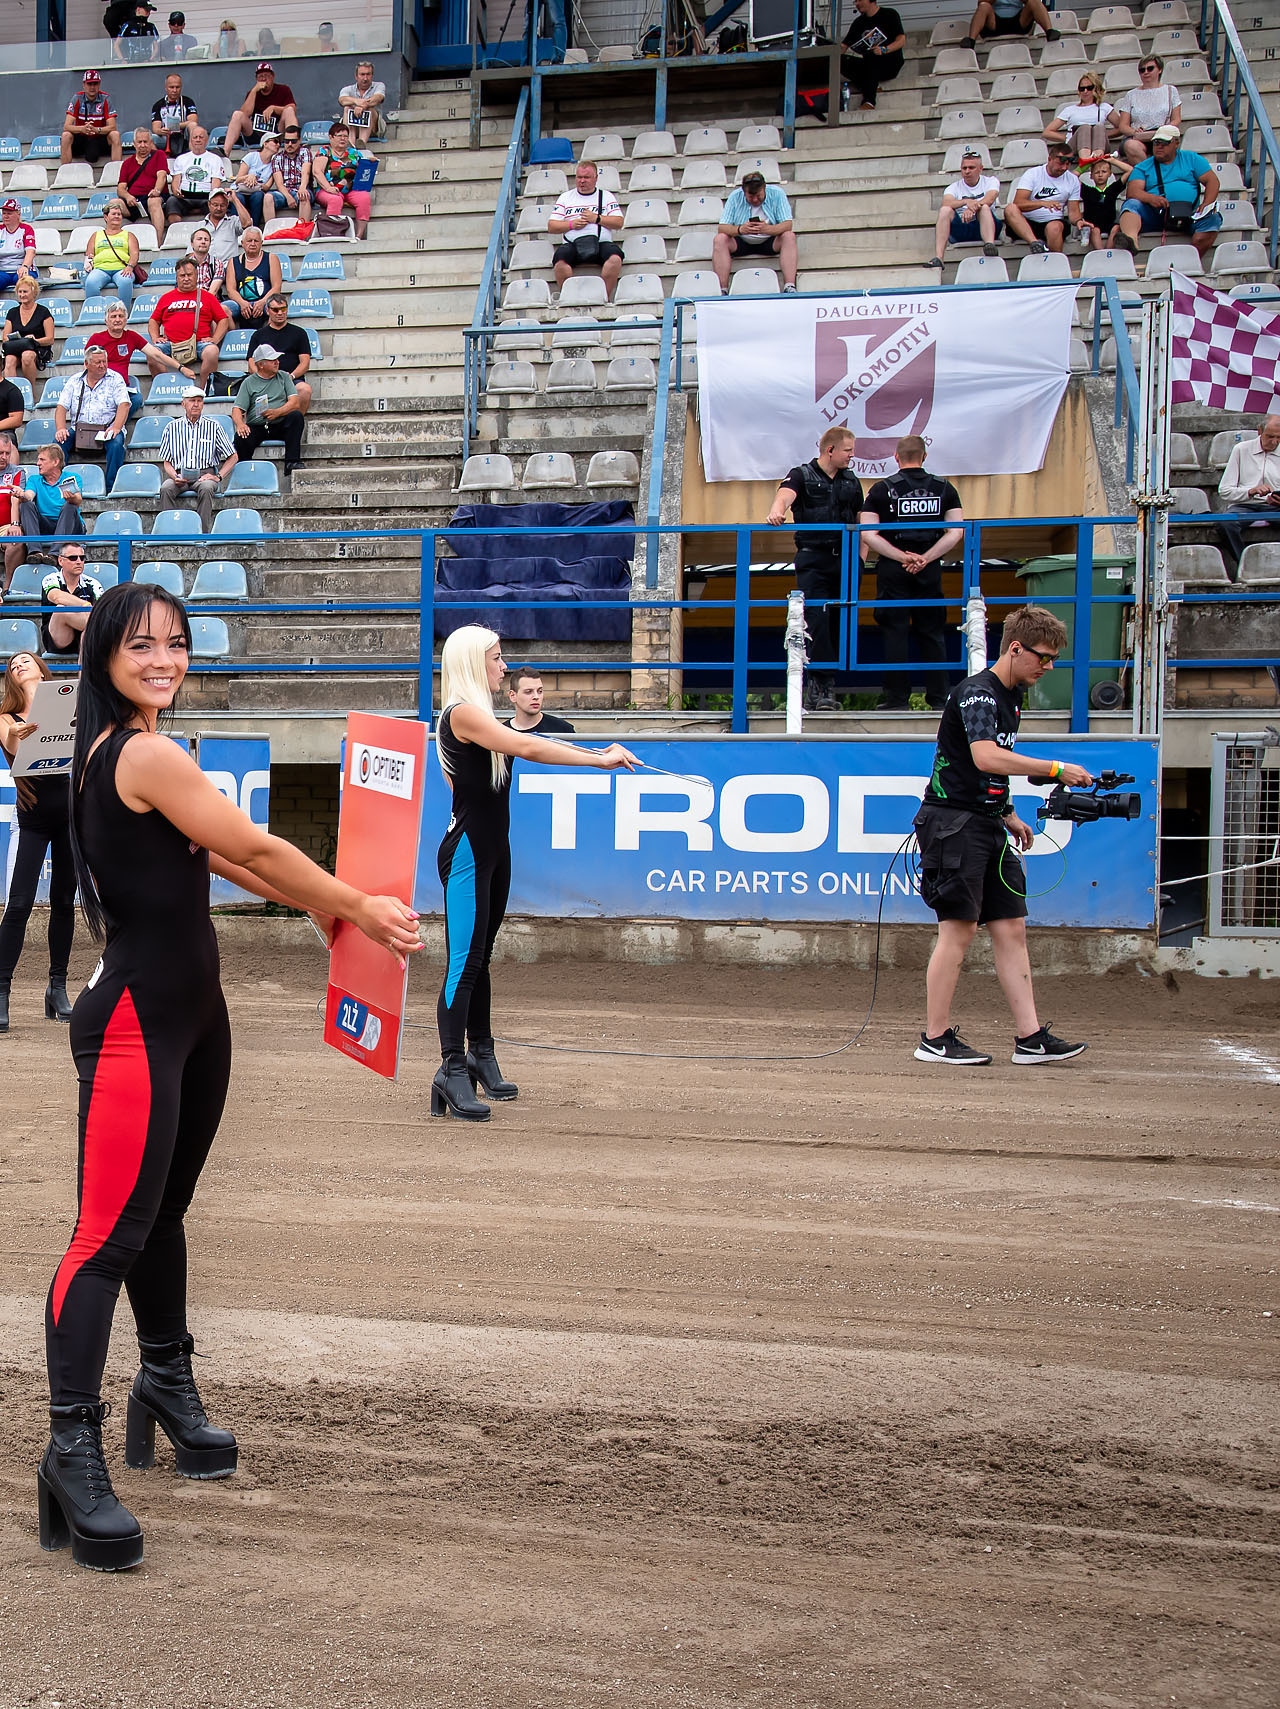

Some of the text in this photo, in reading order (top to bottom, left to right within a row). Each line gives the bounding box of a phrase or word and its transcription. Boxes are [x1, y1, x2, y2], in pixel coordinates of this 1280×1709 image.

[1253, 18, 1263, 27] 15
[1265, 48, 1275, 58] 14
[455, 80, 462, 89] 15
[448, 109, 455, 117] 14
[440, 139, 447, 148] 13
[432, 171, 440, 180] 12
[424, 204, 431, 213] 11
[417, 240, 424, 249] 10
[410, 275, 415, 285] 9
[0, 302, 5, 310] 7
[168, 301, 187, 310] JUST
[816, 302, 938, 319] DAUGAVPILS
[398, 315, 403, 325] 8
[390, 356, 395, 366] 7
[821, 322, 930, 422] LOKOMOTIV
[378, 399, 384, 410] 6
[1235, 434, 1241, 442] 5
[365, 445, 372, 455] 5
[351, 494, 358, 506] 4
[902, 500, 938, 513] GROM
[174, 512, 180, 520] 2
[339, 544, 346, 556] 3
[94, 565, 99, 573] 3
[11, 622, 17, 630] 4
[40, 734, 75, 743] OSTRZE
[38, 758, 60, 768] 2LŻ
[373, 755, 405, 782] OPTIBET
[647, 869, 706, 892] CAR
[715, 870, 809, 894] PARTS
[342, 1003, 358, 1032] 2LŻ
